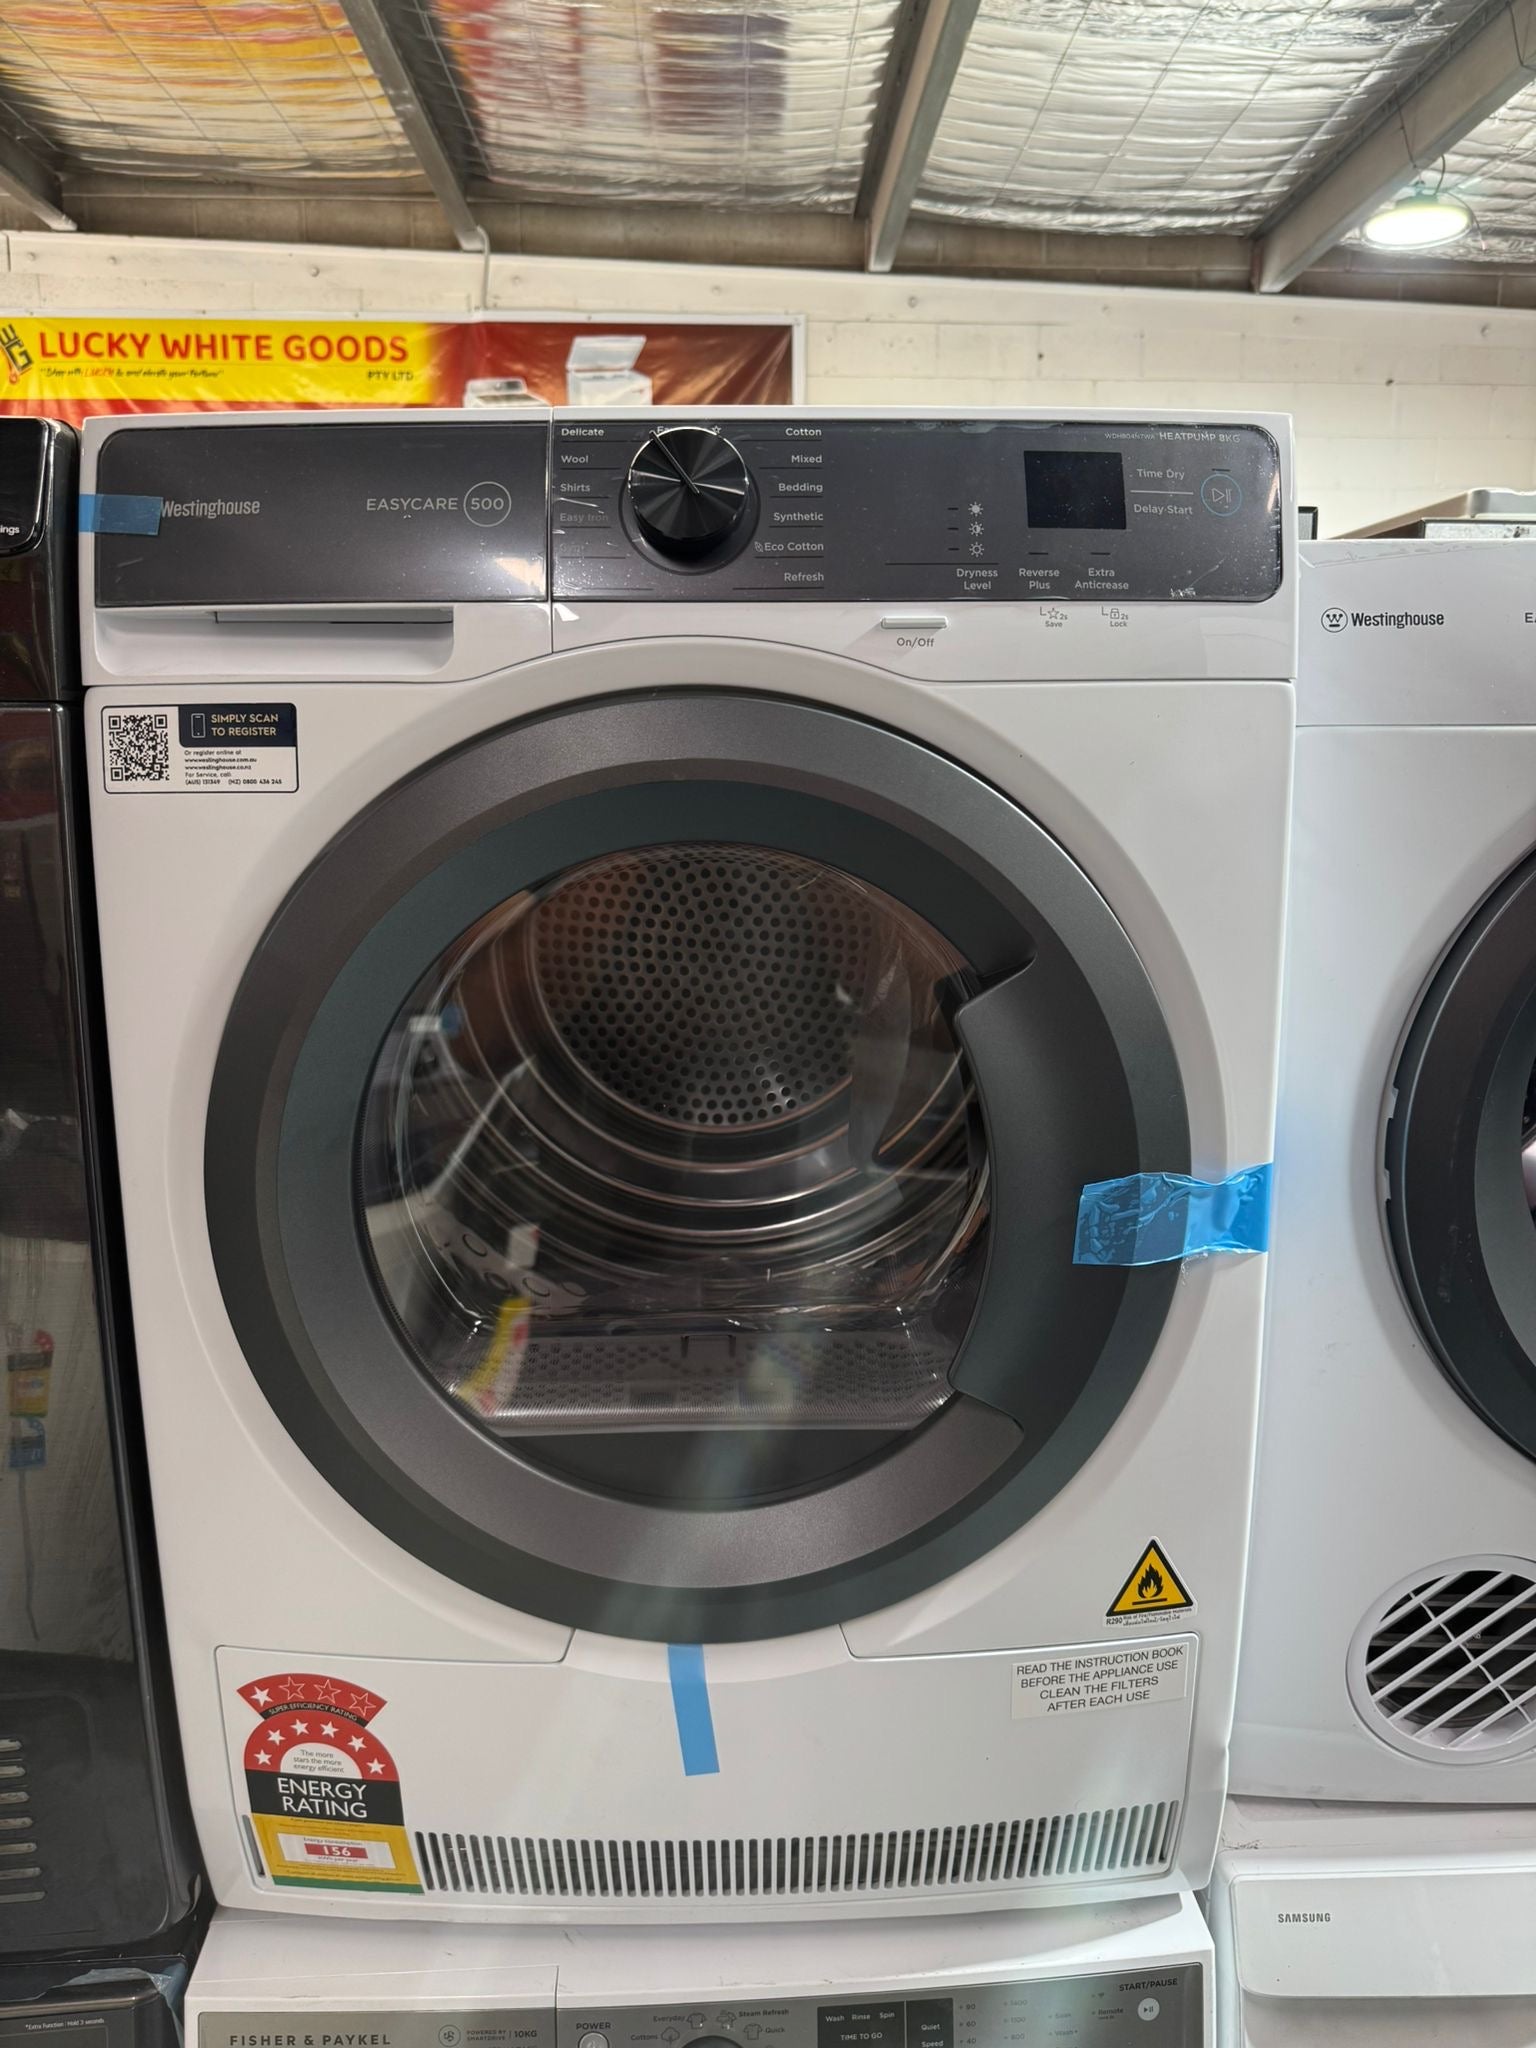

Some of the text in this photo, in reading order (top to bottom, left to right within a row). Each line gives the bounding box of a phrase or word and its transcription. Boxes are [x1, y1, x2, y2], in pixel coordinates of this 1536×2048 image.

[39, 331, 409, 362] LUCKY WHITE GOODS
[393, 371, 414, 382] LTD
[561, 427, 604, 436] Delicate
[785, 427, 822, 436] Cotton
[1160, 432, 1216, 441] HEATPUMP
[1219, 433, 1241, 442] 8KG
[560, 454, 589, 464] Wool
[791, 454, 822, 464] Mixed
[1136, 468, 1185, 482] Time Dry
[560, 483, 590, 493] Shirts
[778, 482, 824, 494] Bedding
[162, 500, 260, 519] Westinghouse
[366, 498, 504, 511] EASYCARE 500
[1134, 504, 1193, 517] Delay Start
[560, 512, 584, 524] Easy
[773, 511, 824, 523] Synthetic
[764, 542, 824, 552] Eco Cotton
[784, 572, 824, 582] Refresh
[956, 568, 998, 580] Dryness
[1018, 568, 1060, 578] Reverse
[1088, 568, 1115, 578] Extra
[963, 580, 992, 590] Level
[1029, 580, 1051, 590] Plus
[1074, 580, 1130, 590] Anticrease
[1351, 612, 1444, 629] Westinghouse
[896, 637, 935, 648] On/Off
[211, 714, 278, 724] SIMPLY SCAN
[211, 727, 277, 736] TO REGISTER
[1016, 1646, 1184, 1675] READ THE INSTRUCTION BOOK
[1021, 1660, 1178, 1688] BEFORE THE APPLIANCE USE
[1040, 1676, 1159, 1700] CLEAN THE FILTERS
[1047, 1690, 1150, 1712] AFTER EACH USE
[269, 1702, 358, 1720] SUPER EFFICIENCY RATING
[277, 1778, 367, 1800] ENERGY
[282, 1797, 368, 1818] RATING
[324, 1846, 351, 1856] 156
[1278, 1912, 1331, 1923] SAMSUNG
[1119, 1978, 1178, 1991] START/PAUSE
[576, 2022, 611, 2030] POWER
[230, 2034, 391, 2046] FISHER & PAYKEL
[921, 2040, 944, 2048] Speed
